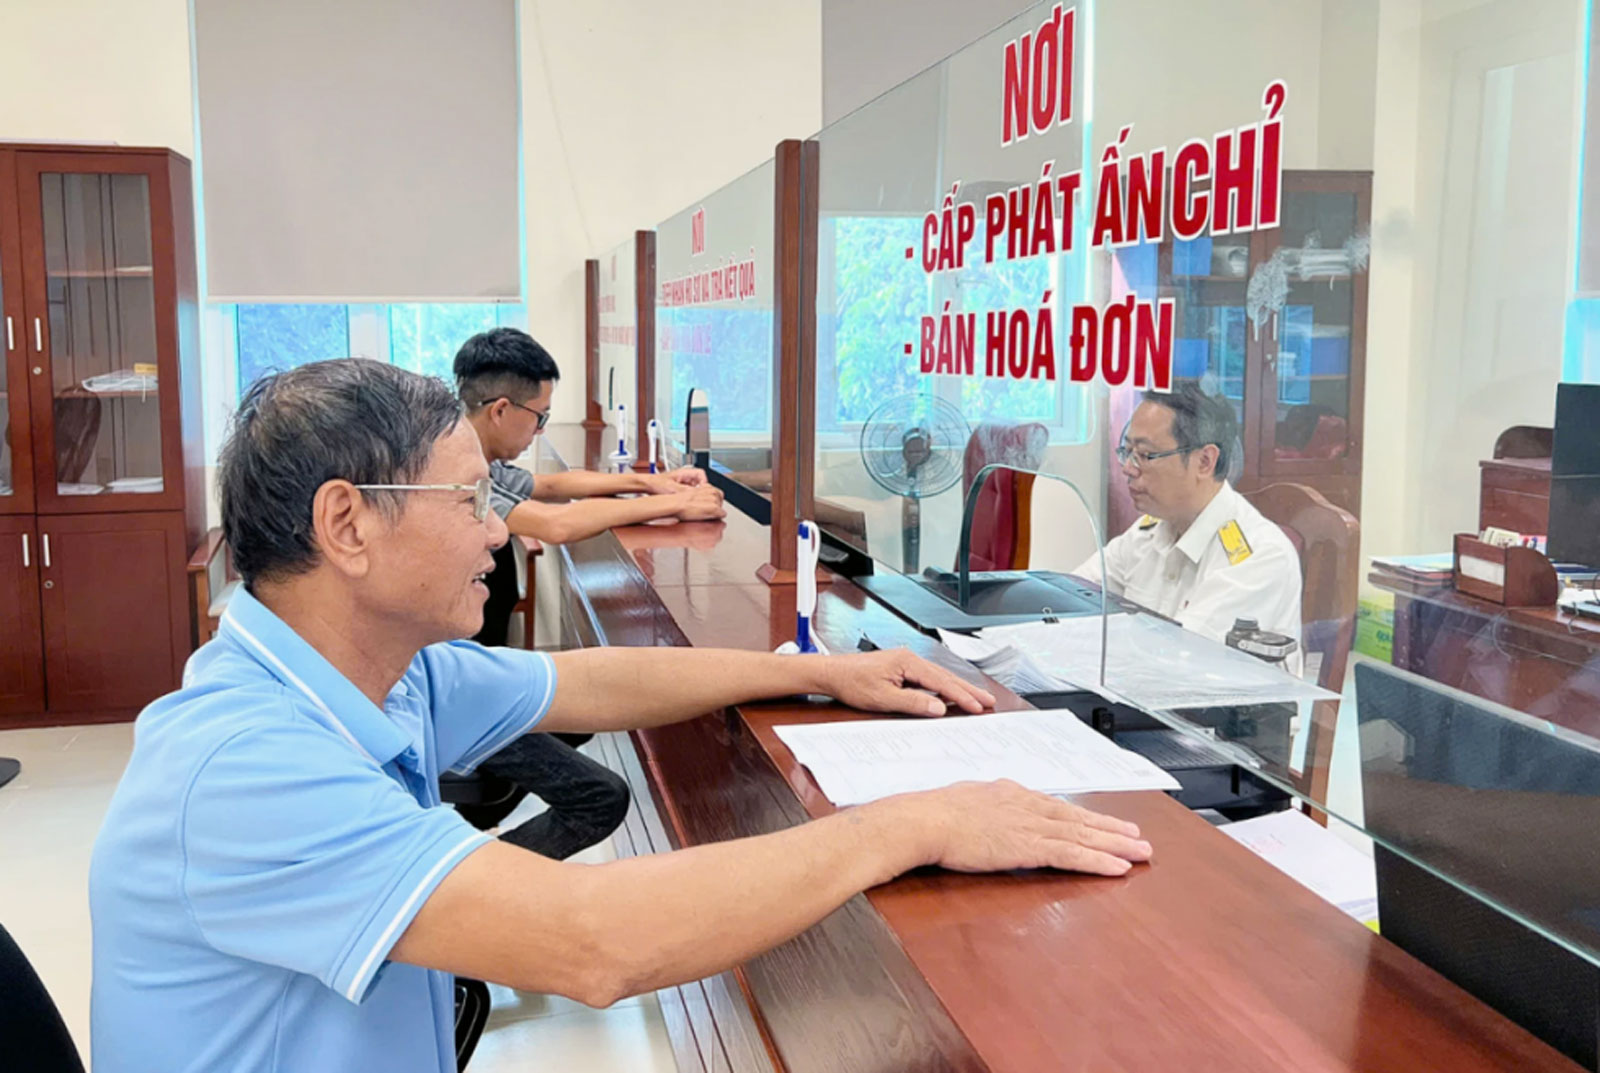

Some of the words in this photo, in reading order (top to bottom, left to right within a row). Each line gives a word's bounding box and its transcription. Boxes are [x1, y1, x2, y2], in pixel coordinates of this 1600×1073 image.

[1002, 3, 1075, 145] NƠI
[920, 182, 975, 275] CẤP
[984, 160, 1081, 264] PHÁT
[920, 300, 975, 376] BÁN
[984, 290, 1056, 382] HOÁ
[1069, 294, 1176, 394] ĐƠN
